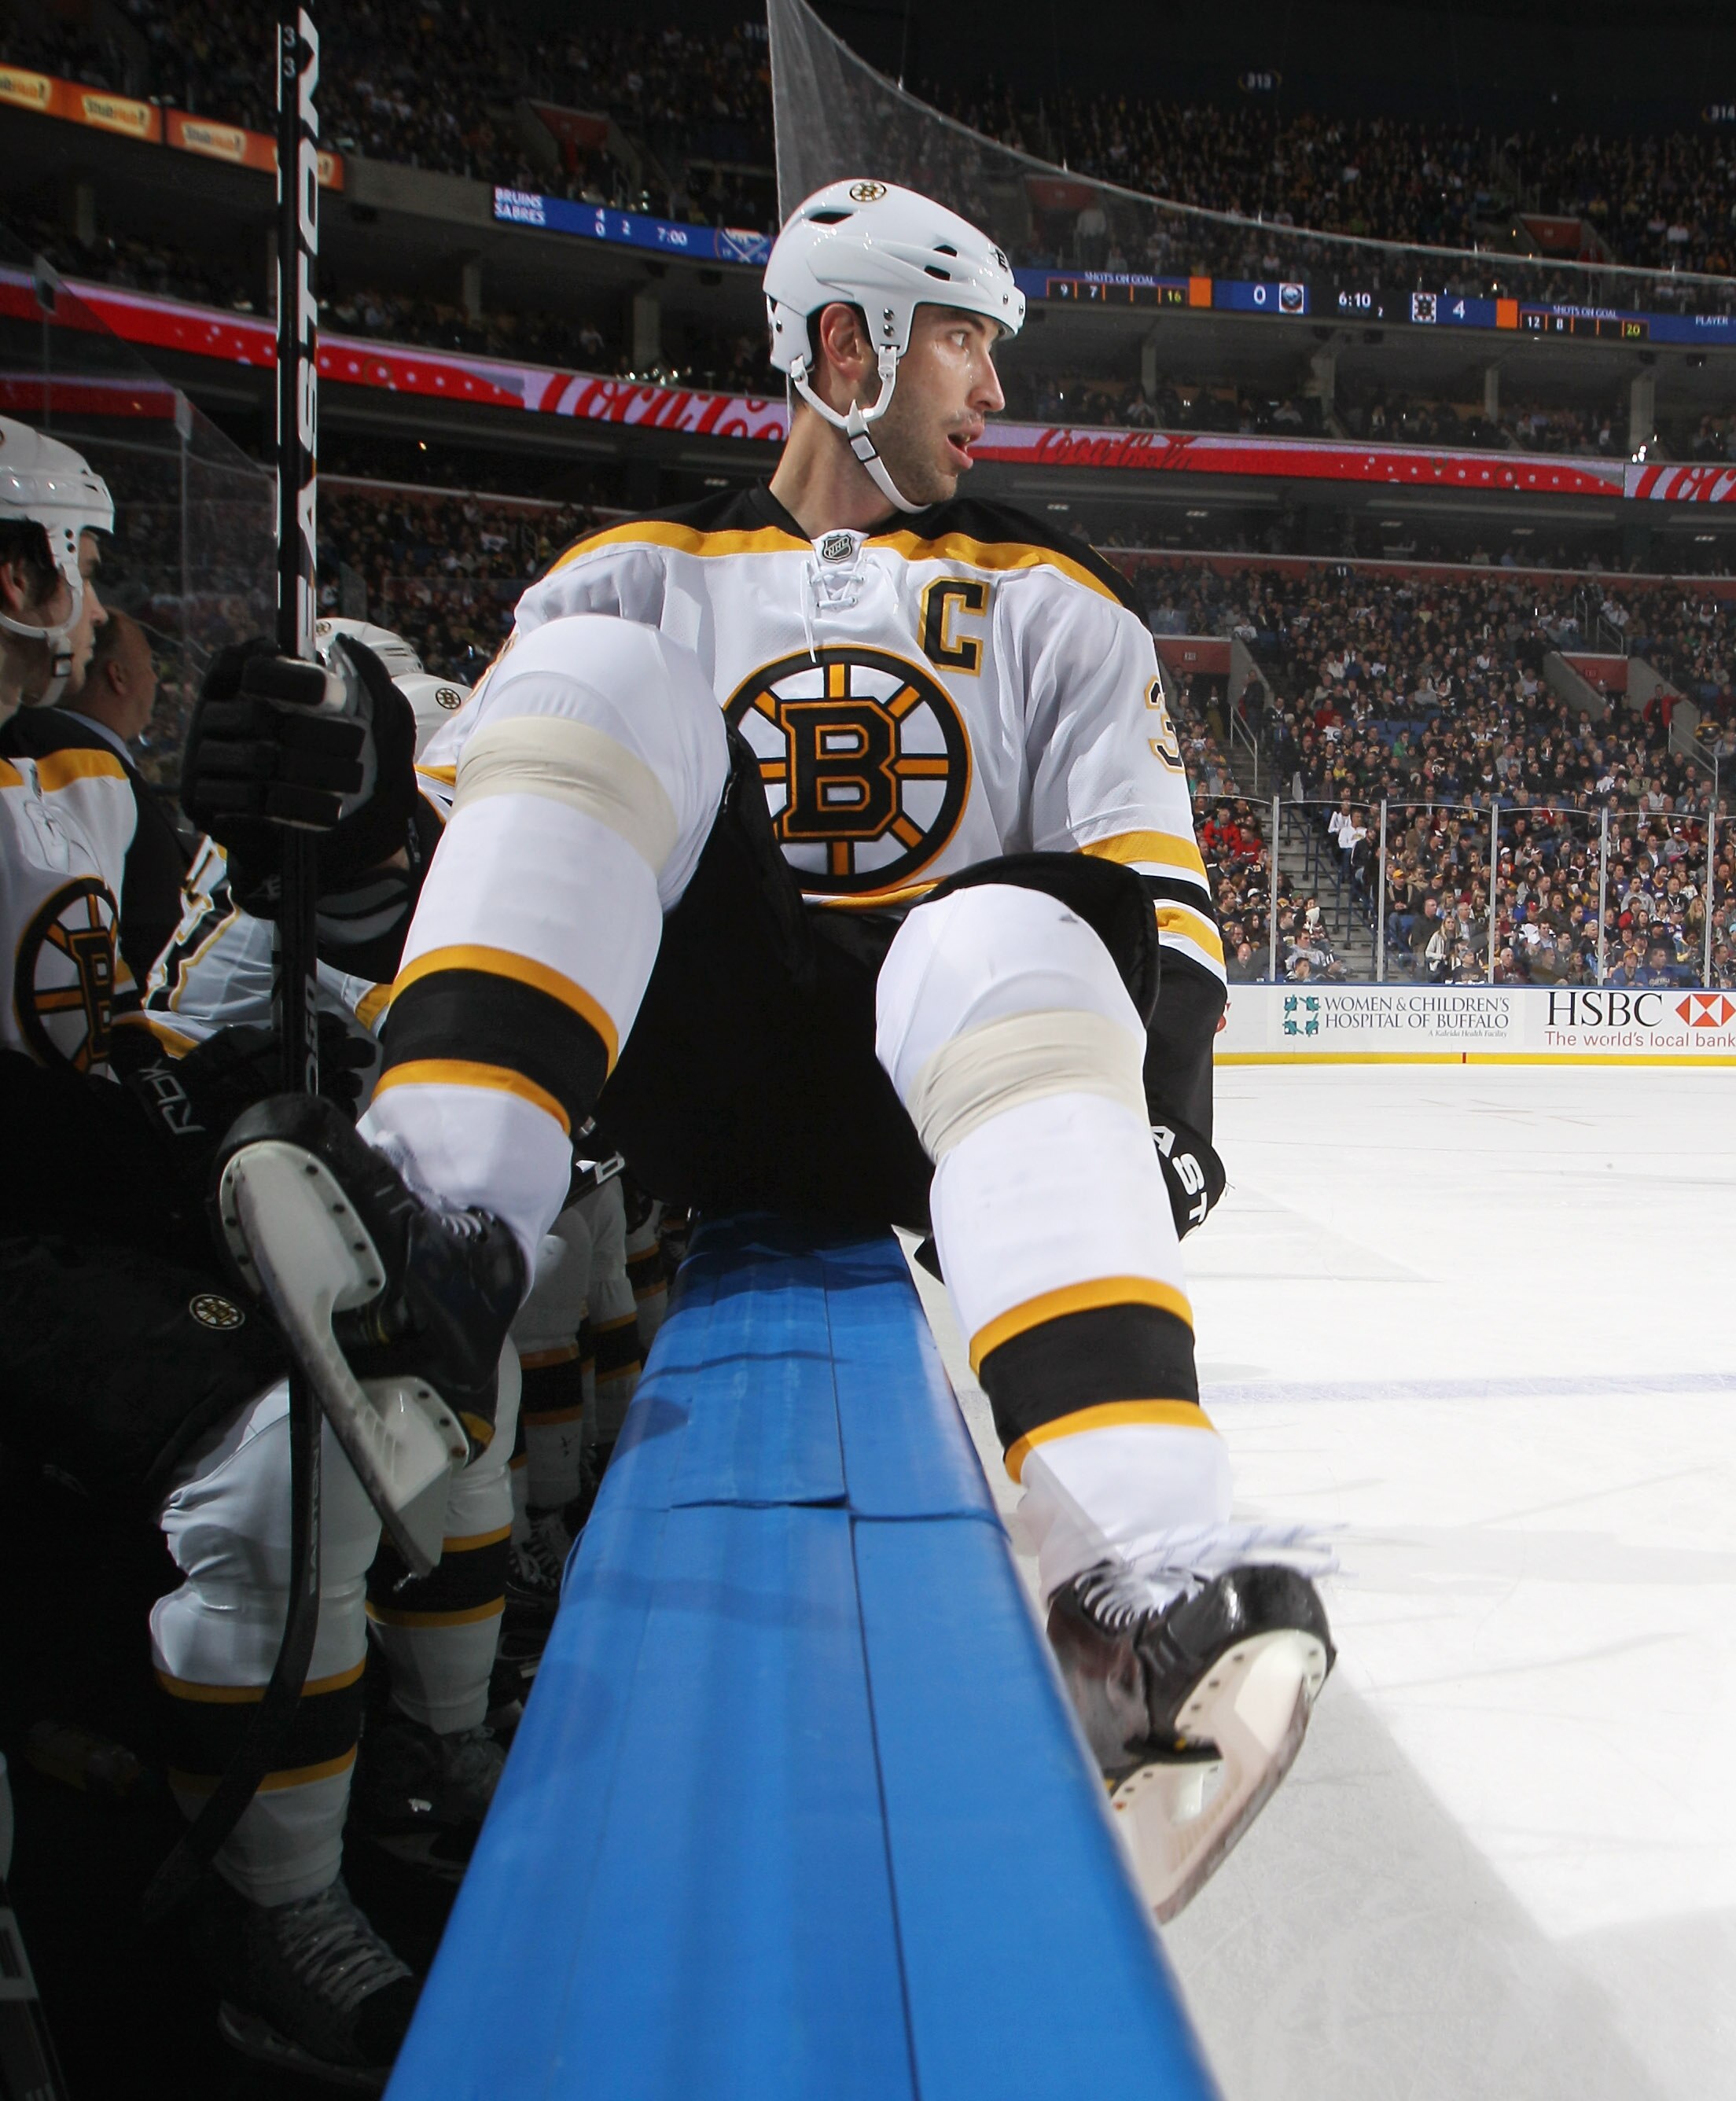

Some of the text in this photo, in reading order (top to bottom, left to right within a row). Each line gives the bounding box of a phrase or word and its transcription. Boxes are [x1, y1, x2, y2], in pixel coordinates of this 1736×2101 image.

[495, 187, 542, 208] BRUINS
[495, 203, 546, 226] SABRES
[657, 226, 688, 246] 7:00
[1084, 270, 1156, 285] SHOTS ON GOAL
[1089, 285, 1098, 298] 7
[1253, 285, 1466, 318] 0 6:10 4
[1553, 304, 1618, 319] SHOTS ON GOAL
[1695, 315, 1729, 326] PLAYER
[297, 6, 319, 662] EASTON
[1527, 315, 1540, 328] 12
[1627, 323, 1641, 337] 20
[917, 576, 990, 677] C
[778, 697, 899, 841] B
[1324, 996, 1510, 1013] WOMEN & CHILDREN'S
[1545, 991, 1663, 1027] HSBC
[1325, 1014, 1510, 1029] HOSPITAL OF BUFFALO
[1545, 1031, 1736, 1047] The world's local bank
